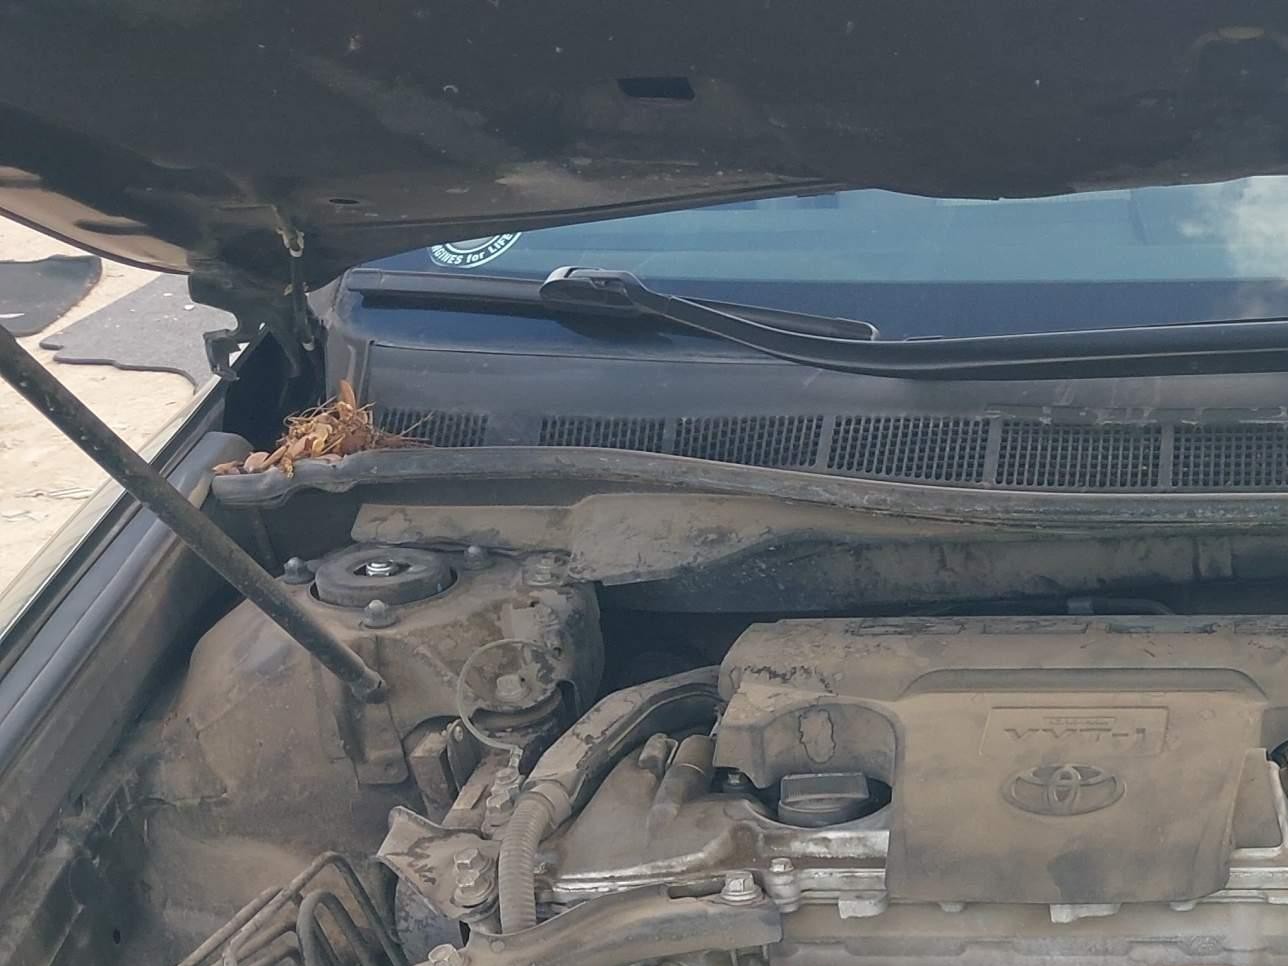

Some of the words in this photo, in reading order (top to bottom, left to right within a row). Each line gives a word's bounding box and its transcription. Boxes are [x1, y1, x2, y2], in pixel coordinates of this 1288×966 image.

[432, 244, 464, 265] NGINES
[466, 251, 486, 263] for
[488, 233, 514, 254] LIFE
